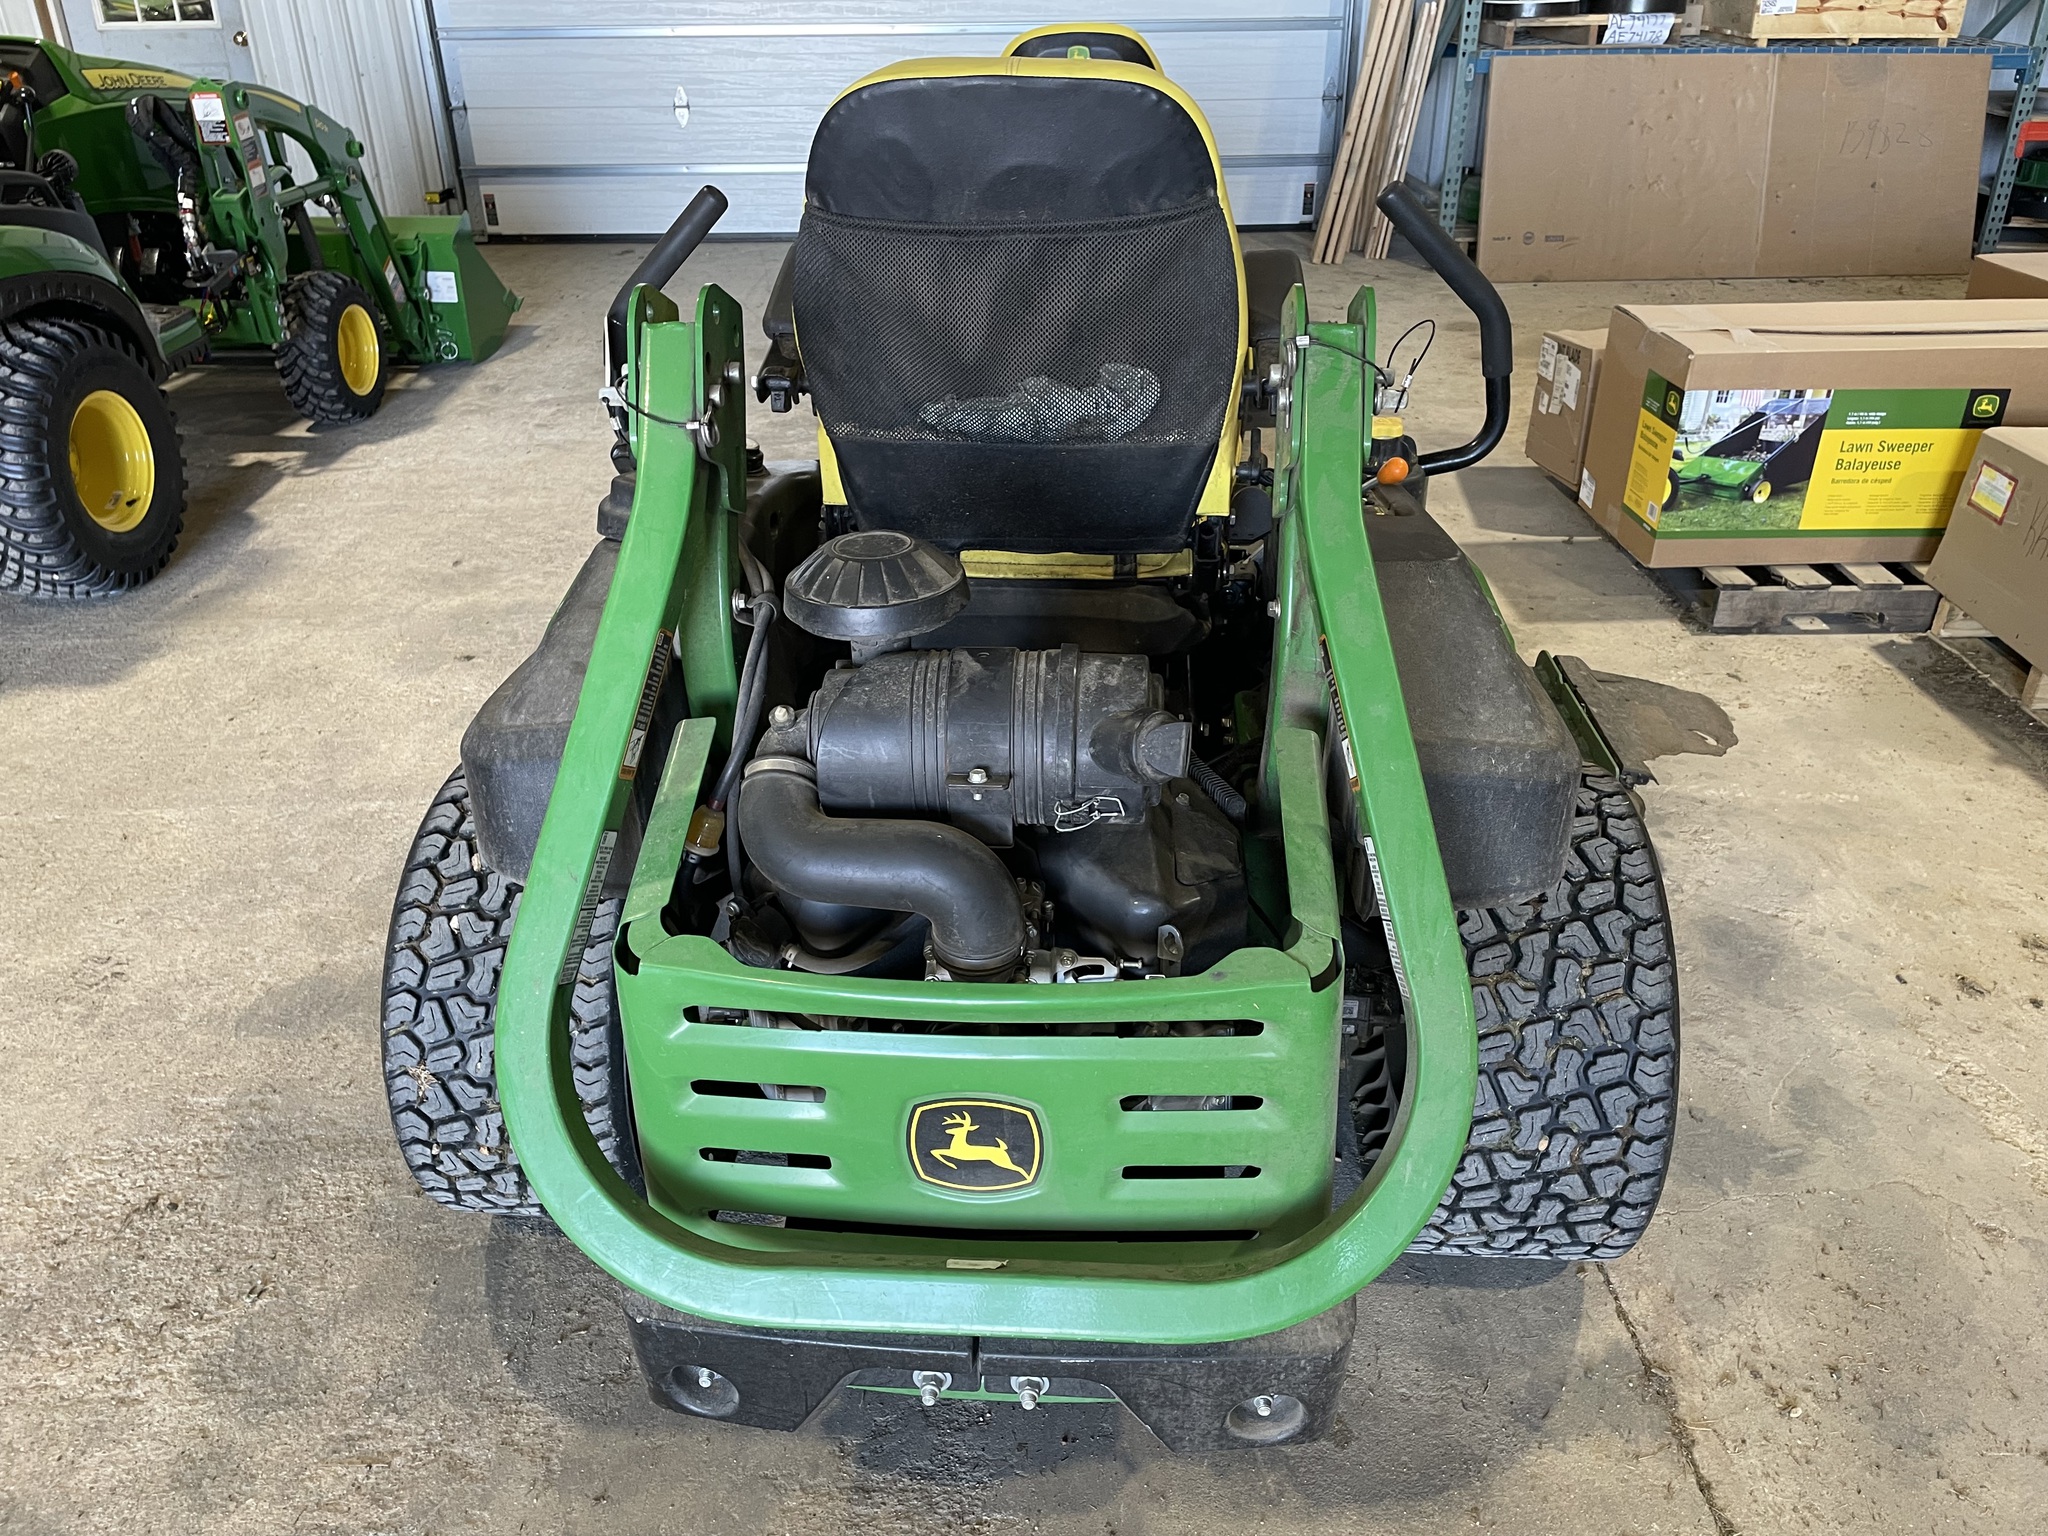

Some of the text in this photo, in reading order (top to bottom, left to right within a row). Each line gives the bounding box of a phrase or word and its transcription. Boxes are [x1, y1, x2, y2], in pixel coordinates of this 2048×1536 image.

[98, 73, 167, 88] JOHN DEERE
[1839, 440, 1935, 455] Lawn Sweeper
[1835, 458, 1902, 473] Balayeuse
[1870, 476, 1893, 485] césped
